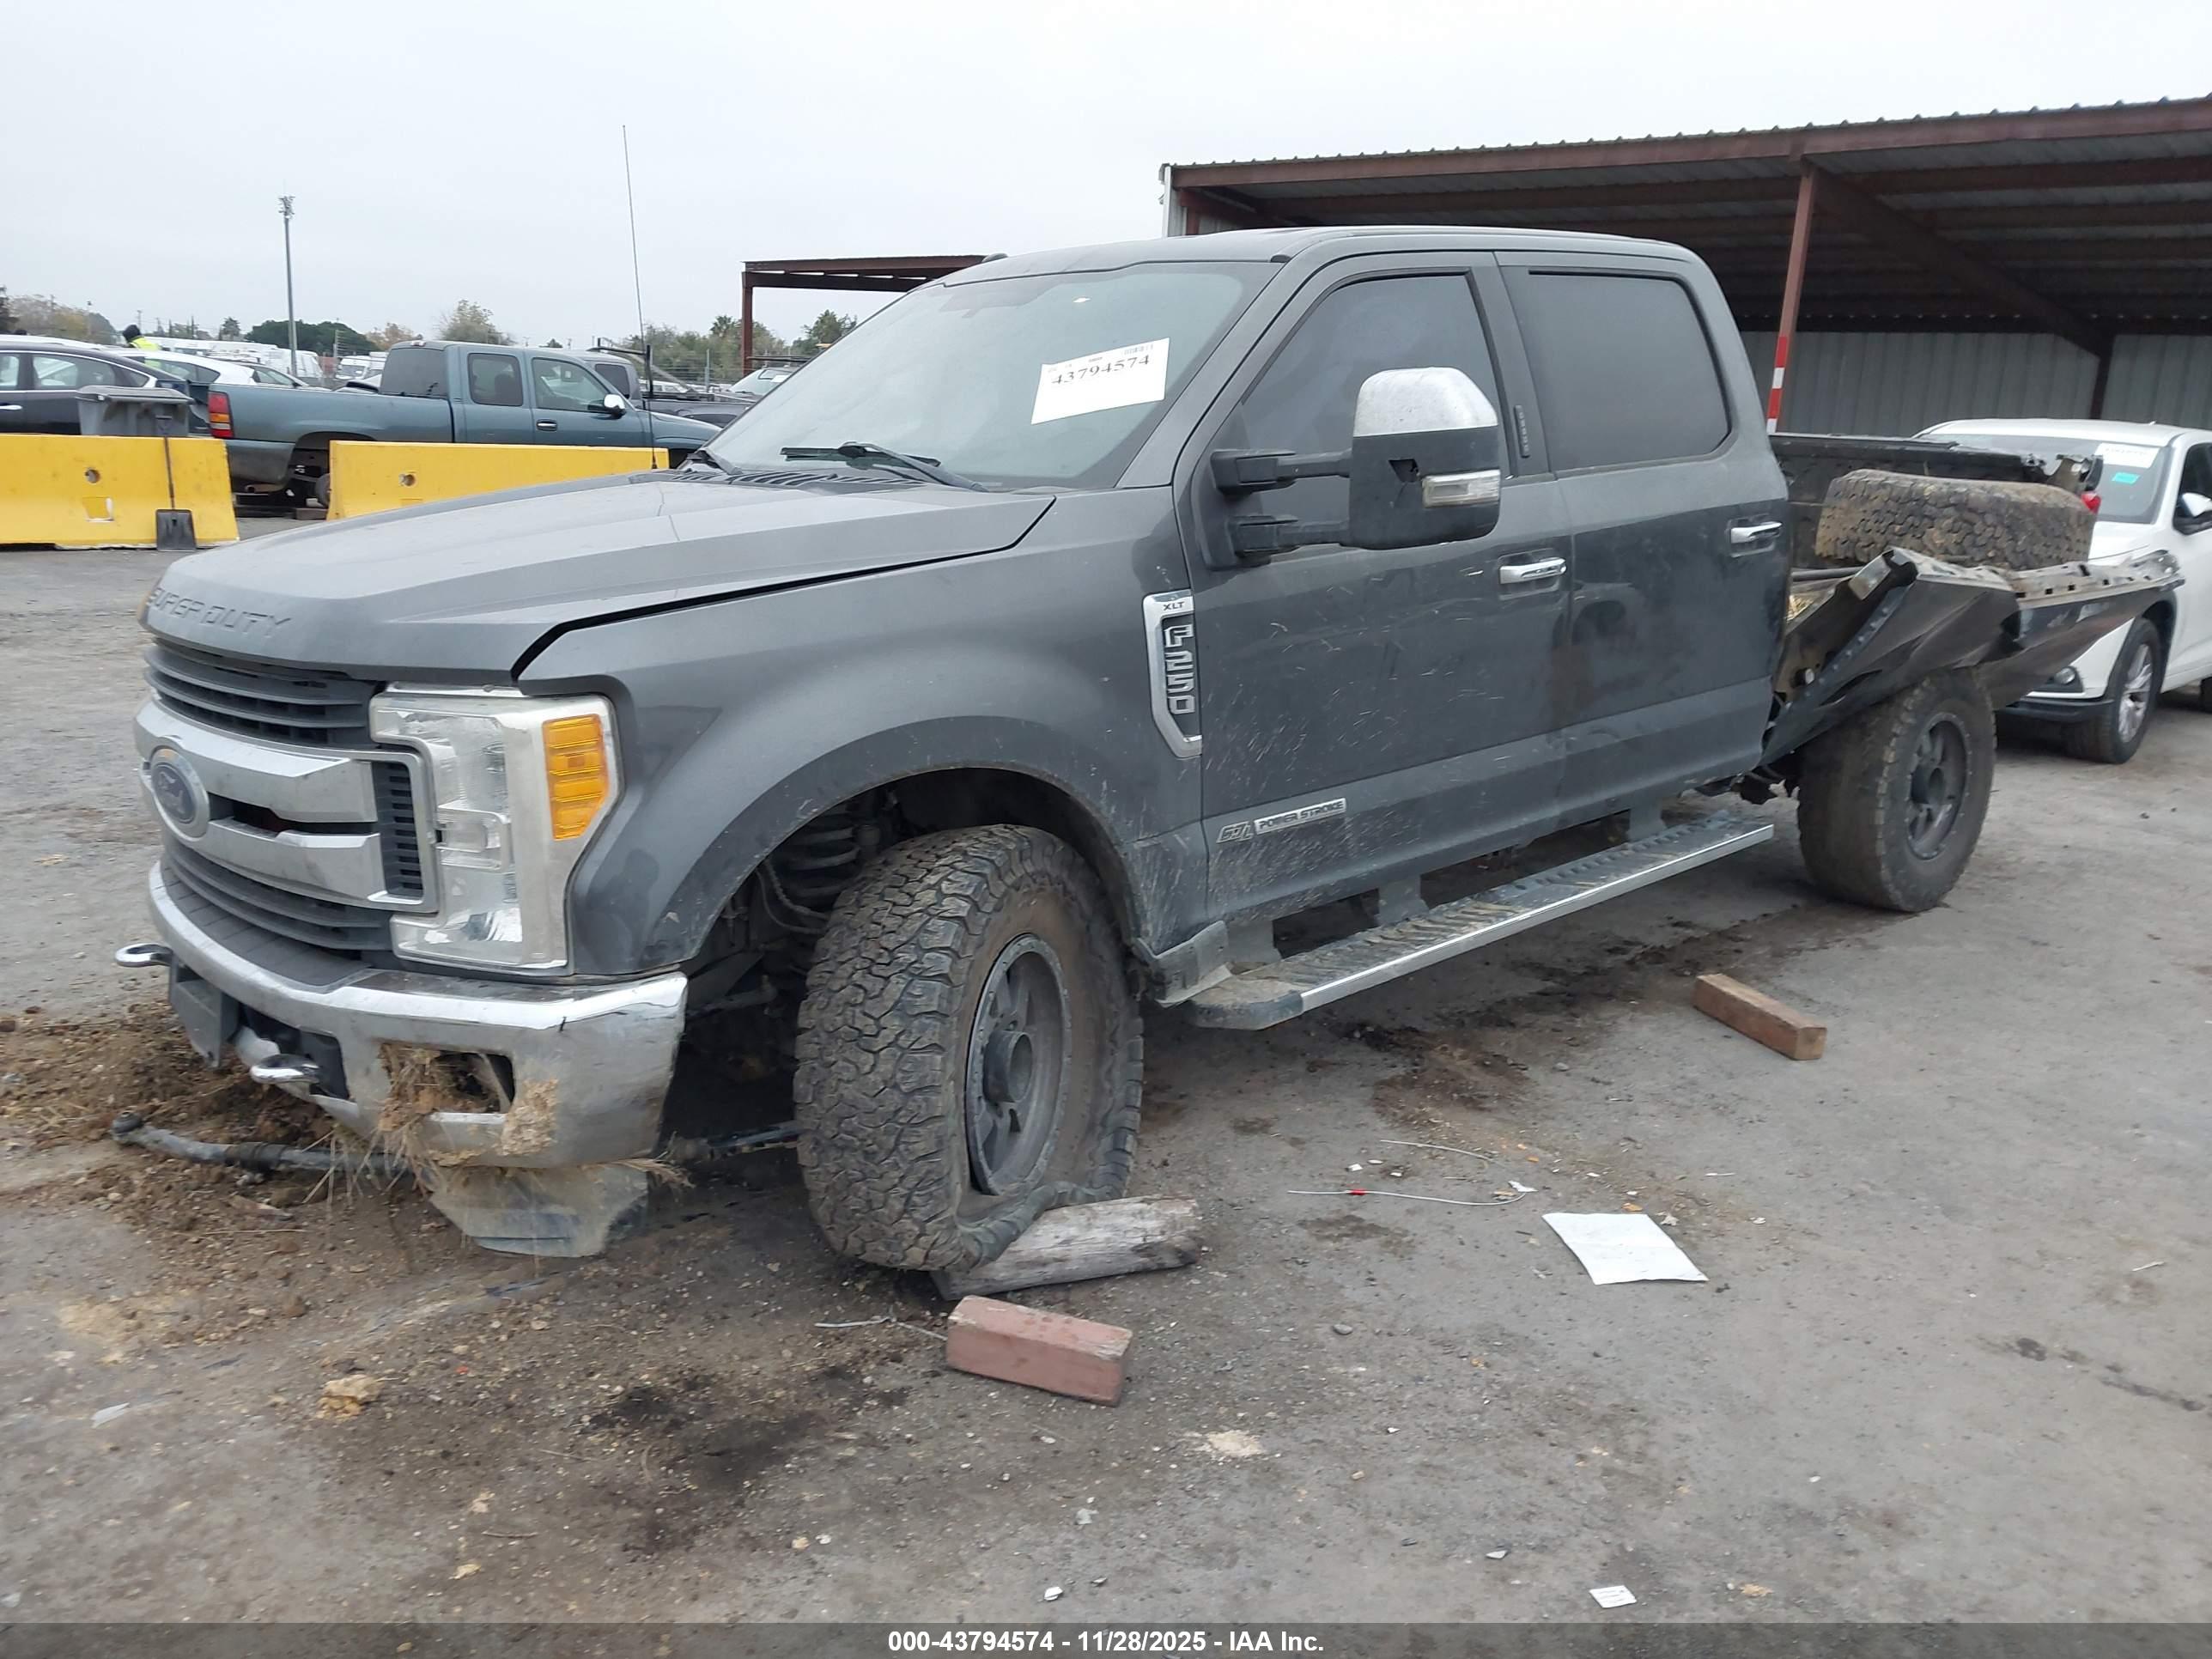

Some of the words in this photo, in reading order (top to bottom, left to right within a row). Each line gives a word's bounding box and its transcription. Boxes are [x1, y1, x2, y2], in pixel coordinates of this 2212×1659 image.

[1050, 355, 1151, 385] 43794574
[201, 605, 292, 638] DUTY
[1163, 601, 1185, 611] XLT
[1164, 624, 1195, 714] F250
